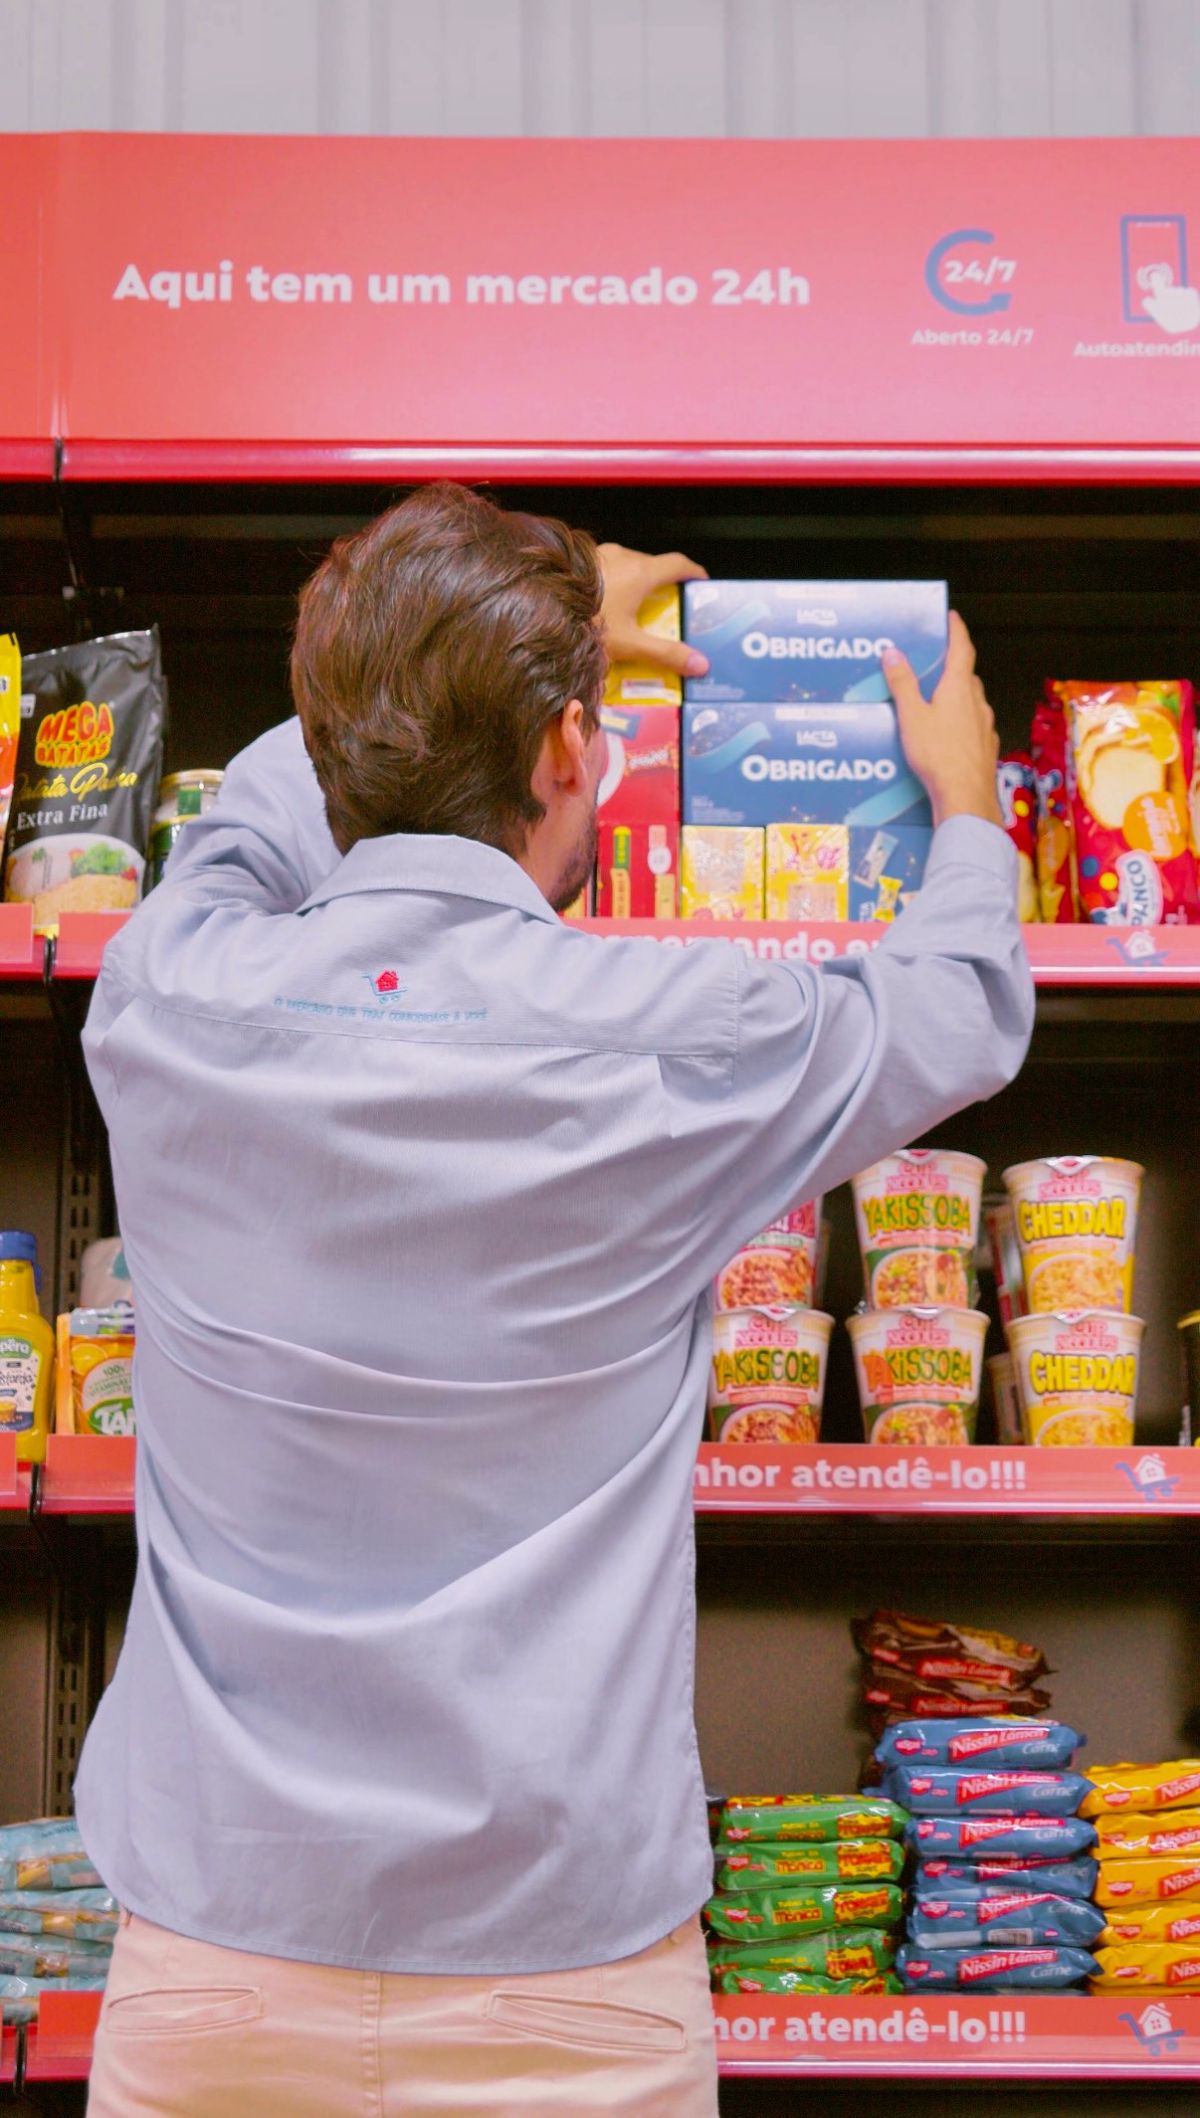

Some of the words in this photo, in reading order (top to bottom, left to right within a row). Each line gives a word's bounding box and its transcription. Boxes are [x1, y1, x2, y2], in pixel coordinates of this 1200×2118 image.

[112, 260, 234, 309] Aqui
[246, 266, 353, 302] tem
[368, 271, 451, 303] um
[466, 267, 698, 306] mercado
[711, 267, 810, 306] 24h
[944, 257, 1017, 285] 24/7
[911, 328, 982, 346] Aberto
[987, 328, 1034, 346] 24/7
[36, 700, 114, 744] MEGA
[35, 735, 111, 768] BATATAS
[741, 753, 897, 782] OBRIGADO
[17, 808, 64, 831] Extra
[69, 802, 109, 823] Fina
[861, 1192, 972, 1238] YAKISSOBA
[1017, 1195, 1127, 1243] CHEDDAR
[711, 1347, 820, 1393] YAKISSOBA
[861, 1347, 973, 1393] YAKISSOBA
[1029, 1350, 1137, 1396] CHEDDAR
[791, 1458, 1026, 1490] atendê-lo!!!
[952, 1733, 998, 1758] Nissin
[959, 1956, 1007, 1977] Nissin
[784, 2008, 1026, 2043] atendê-lo!!!
